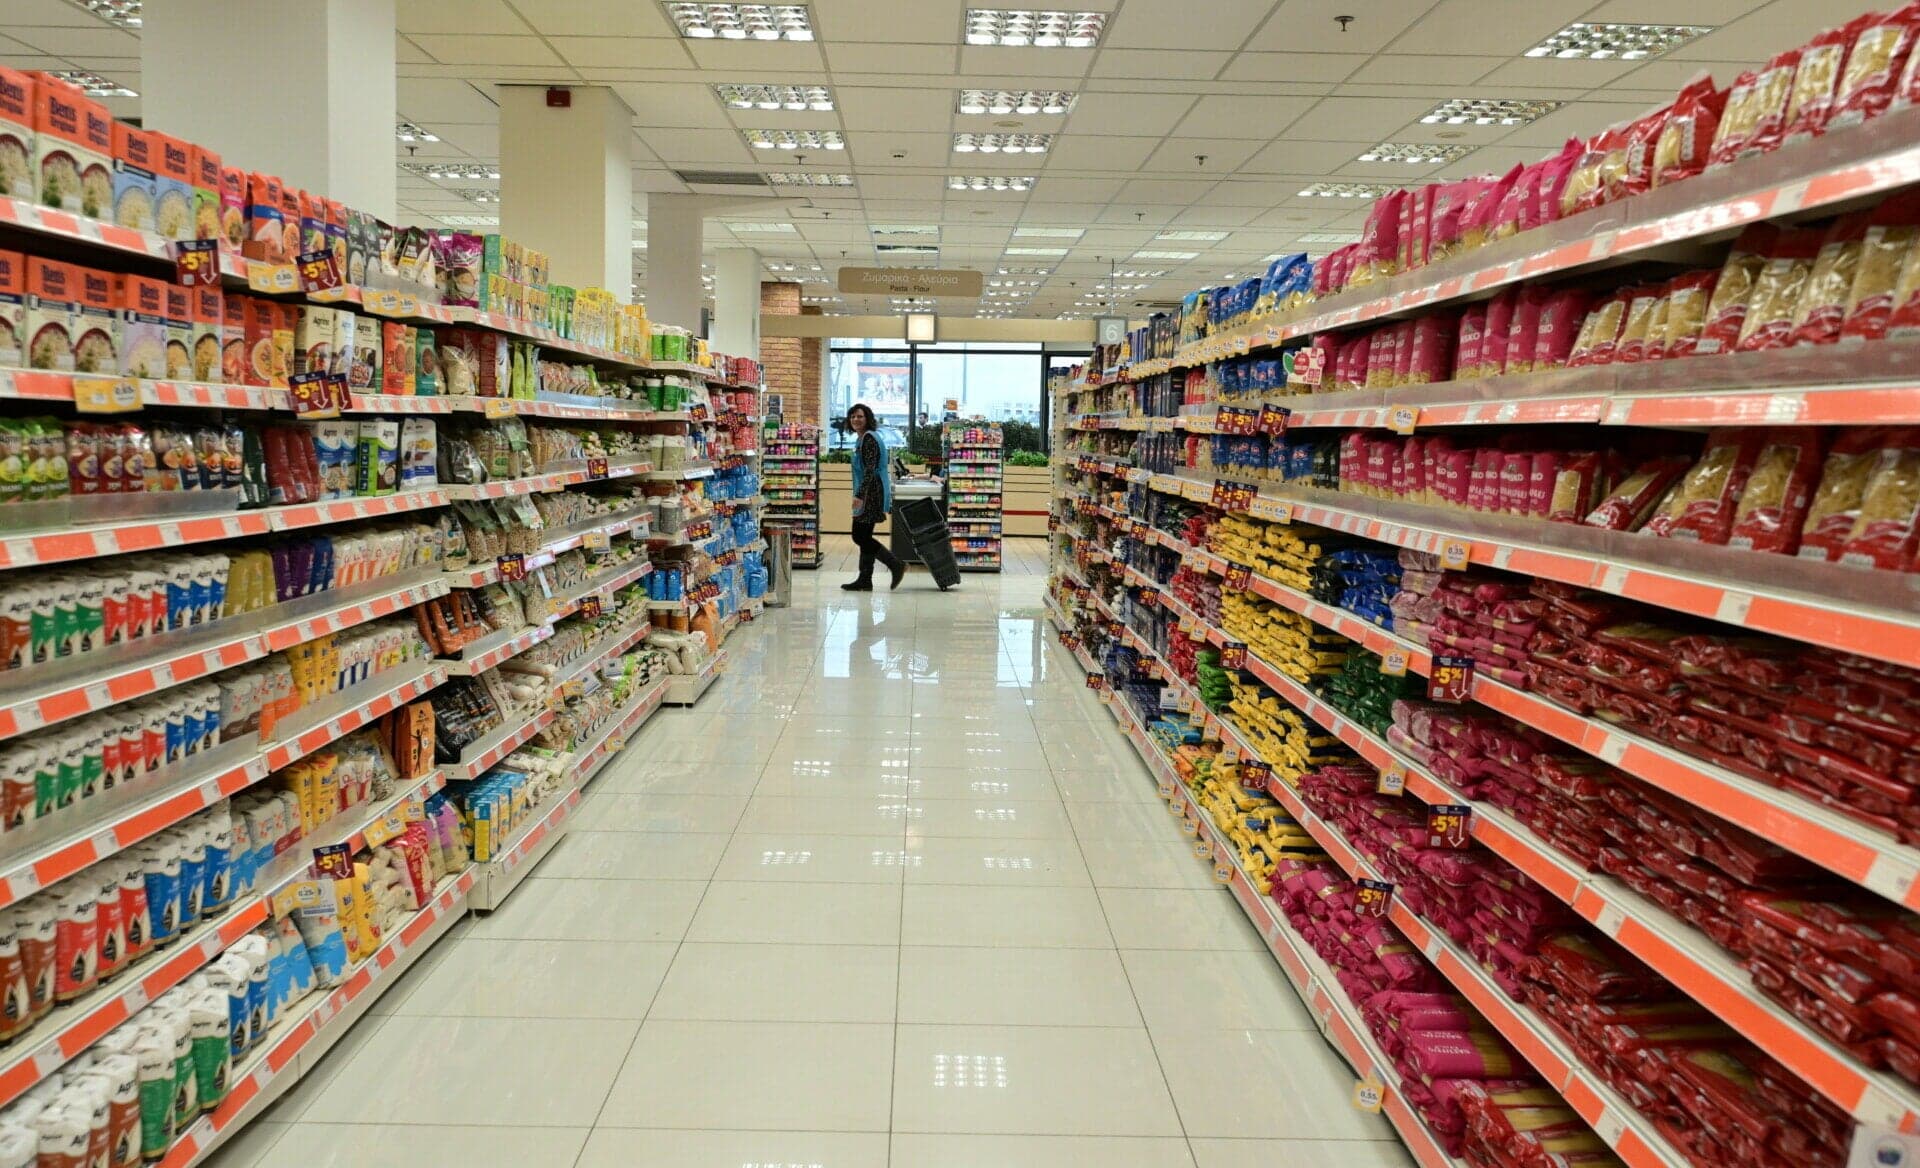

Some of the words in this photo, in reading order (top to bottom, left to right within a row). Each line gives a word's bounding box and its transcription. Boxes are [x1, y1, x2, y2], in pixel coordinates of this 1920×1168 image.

[181, 251, 210, 270] -5%
[303, 262, 329, 279] -5%
[1105, 323, 1119, 342] 6
[294, 382, 320, 399] -5%
[1234, 414, 1252, 426] -5%
[1263, 412, 1282, 424] -5%
[501, 561, 519, 573] -5%
[1228, 570, 1244, 581] -5%
[1224, 648, 1241, 660] -5%
[1434, 667, 1463, 684] -5%
[1246, 768, 1263, 779] -5%
[1432, 815, 1459, 832] -5%
[318, 853, 343, 870] -5%
[1358, 888, 1383, 904] -5%
